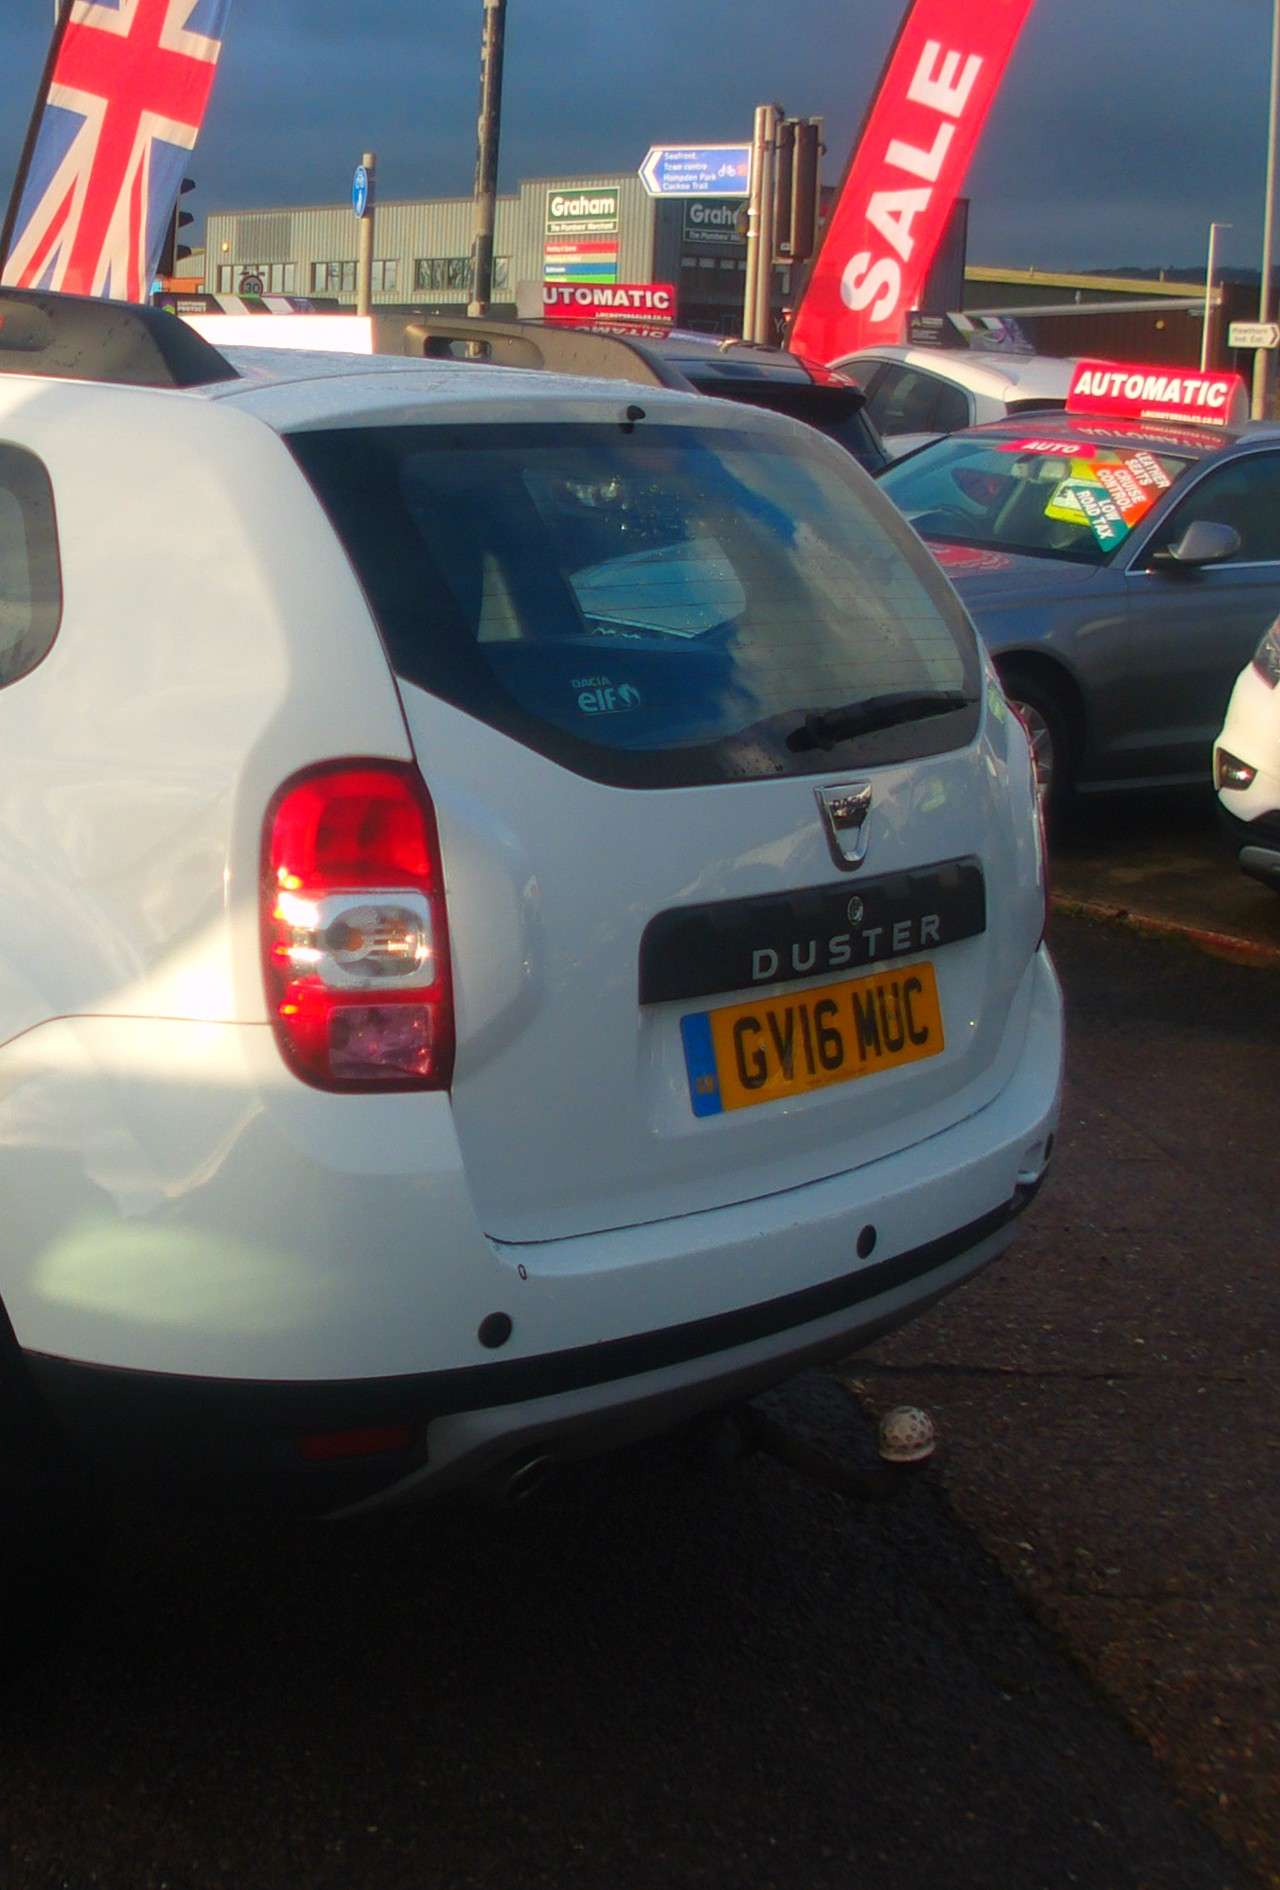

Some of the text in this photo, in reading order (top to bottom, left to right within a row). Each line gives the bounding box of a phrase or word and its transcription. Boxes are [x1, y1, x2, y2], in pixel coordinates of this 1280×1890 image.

[692, 182, 709, 190] Trail
[699, 173, 716, 181] Park
[840, 39, 984, 322] SALE
[551, 195, 615, 217] Graham
[246, 282, 261, 294] 30
[543, 287, 670, 309] UTOMATIC
[1074, 370, 1229, 408] AUTOMATIC
[1021, 442, 1081, 454] AUTO
[1124, 459, 1153, 487] SEATS
[1136, 452, 1172, 489] LEATHER
[1097, 468, 1135, 512] CONTROL
[1114, 468, 1148, 505] CRUISE
[1076, 489, 1116, 539] ROAD TAX
[1099, 498, 1122, 521] LOW
[577, 687, 617, 713] elf
[751, 913, 944, 981] DUSTER
[732, 977, 929, 1090] GV16 MUC
